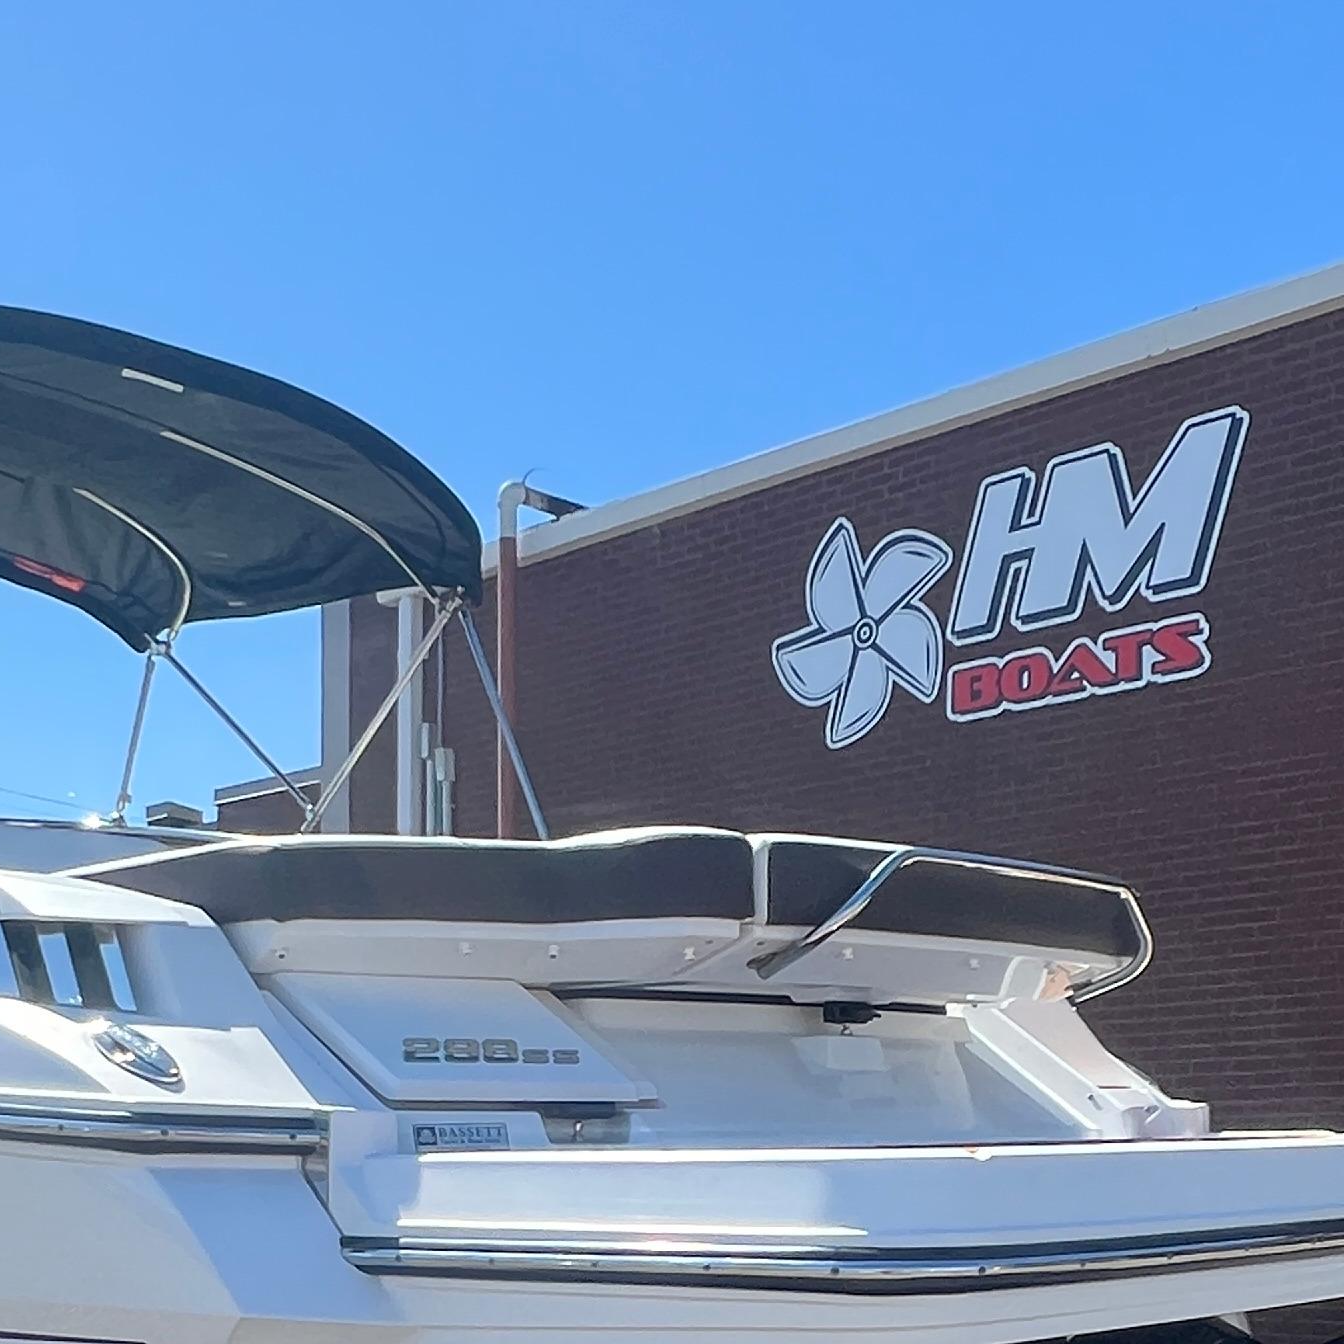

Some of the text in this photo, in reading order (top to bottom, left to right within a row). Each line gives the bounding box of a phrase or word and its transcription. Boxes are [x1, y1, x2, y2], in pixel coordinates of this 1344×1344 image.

[951, 408, 1247, 640] HM
[952, 618, 1208, 716] BOATS
[437, 1126, 503, 1138] BASSETT
